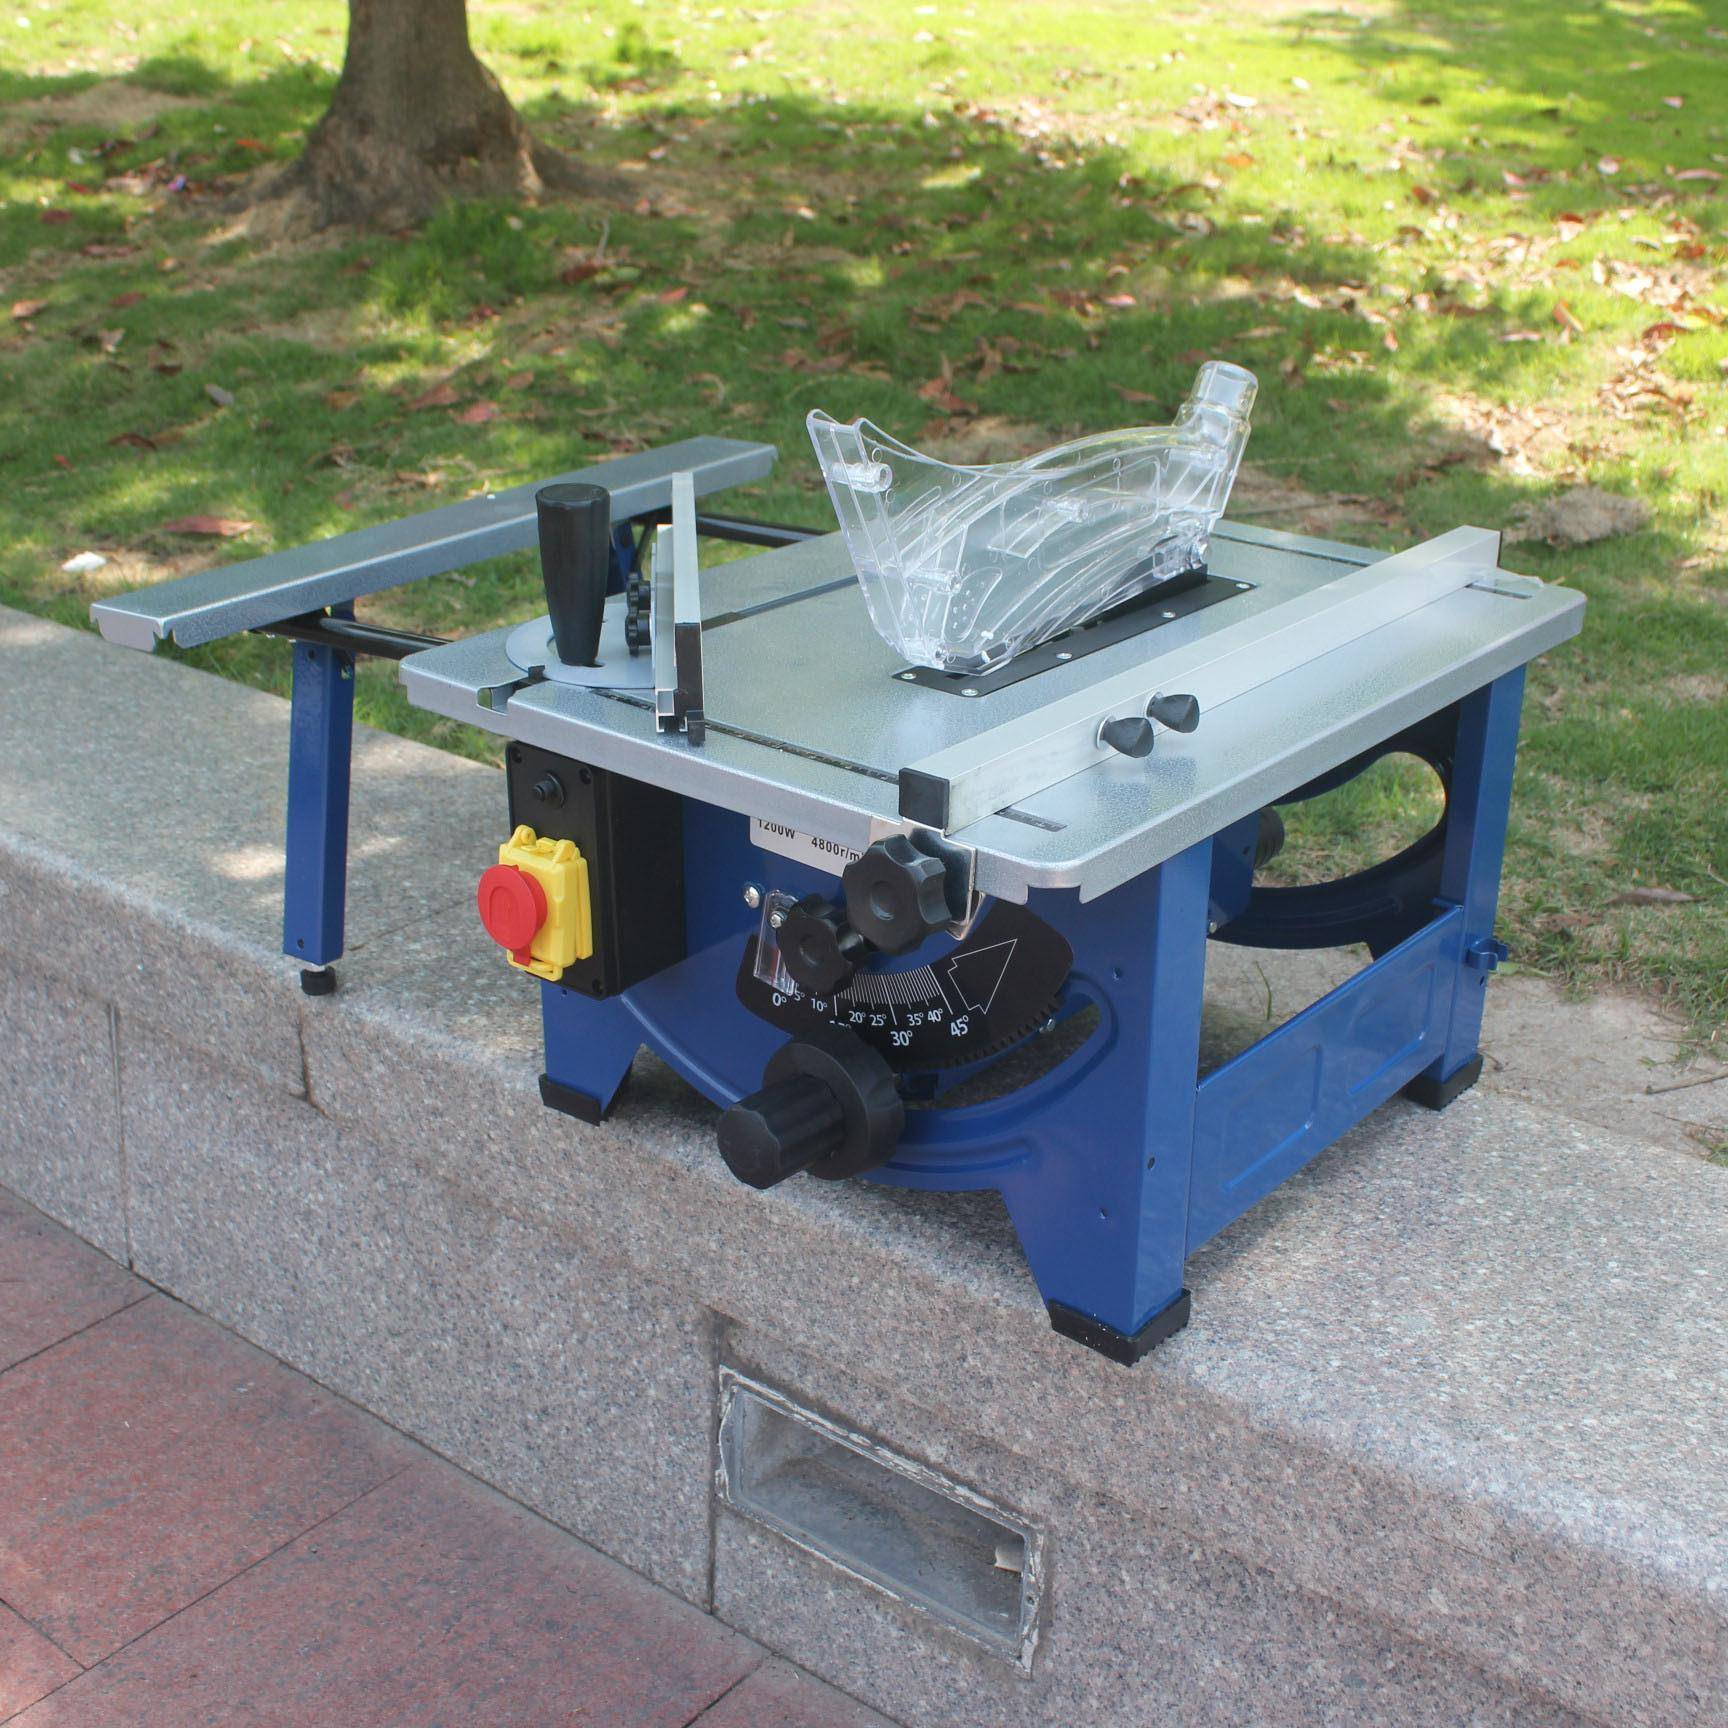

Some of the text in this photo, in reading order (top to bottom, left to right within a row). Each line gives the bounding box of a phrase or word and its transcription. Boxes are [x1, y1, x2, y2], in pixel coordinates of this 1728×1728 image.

[759, 819, 864, 861] 1200W 4800r/m
[811, 998, 828, 1012] 10°
[848, 1010, 867, 1023] 20°
[869, 1013, 887, 1026] 25°
[890, 1030, 913, 1046] 30°
[906, 1012, 924, 1026] 35°
[927, 1008, 943, 1023] 40°
[950, 1014, 969, 1037] 45°
